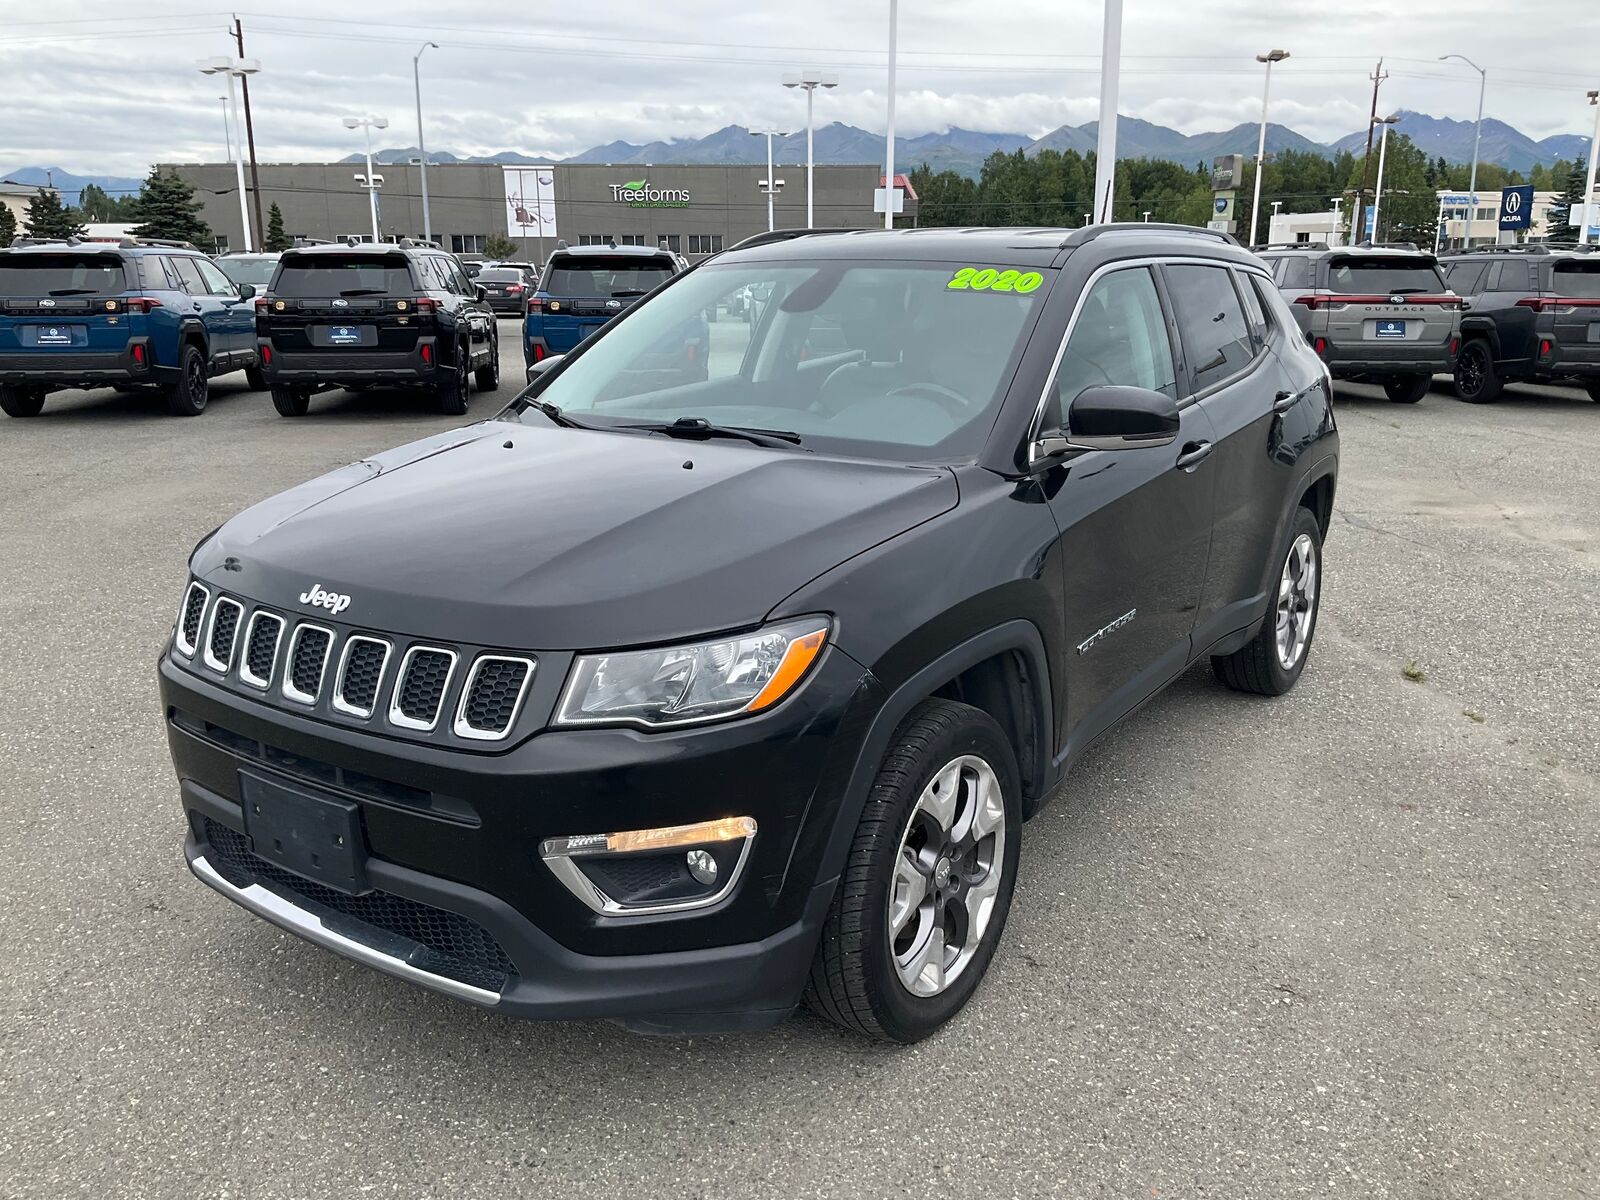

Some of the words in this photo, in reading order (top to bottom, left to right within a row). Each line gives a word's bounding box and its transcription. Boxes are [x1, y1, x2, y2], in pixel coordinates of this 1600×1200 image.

[609, 184, 690, 202] Treeforms
[947, 267, 1043, 293] 2020
[299, 583, 352, 615] Jeep
